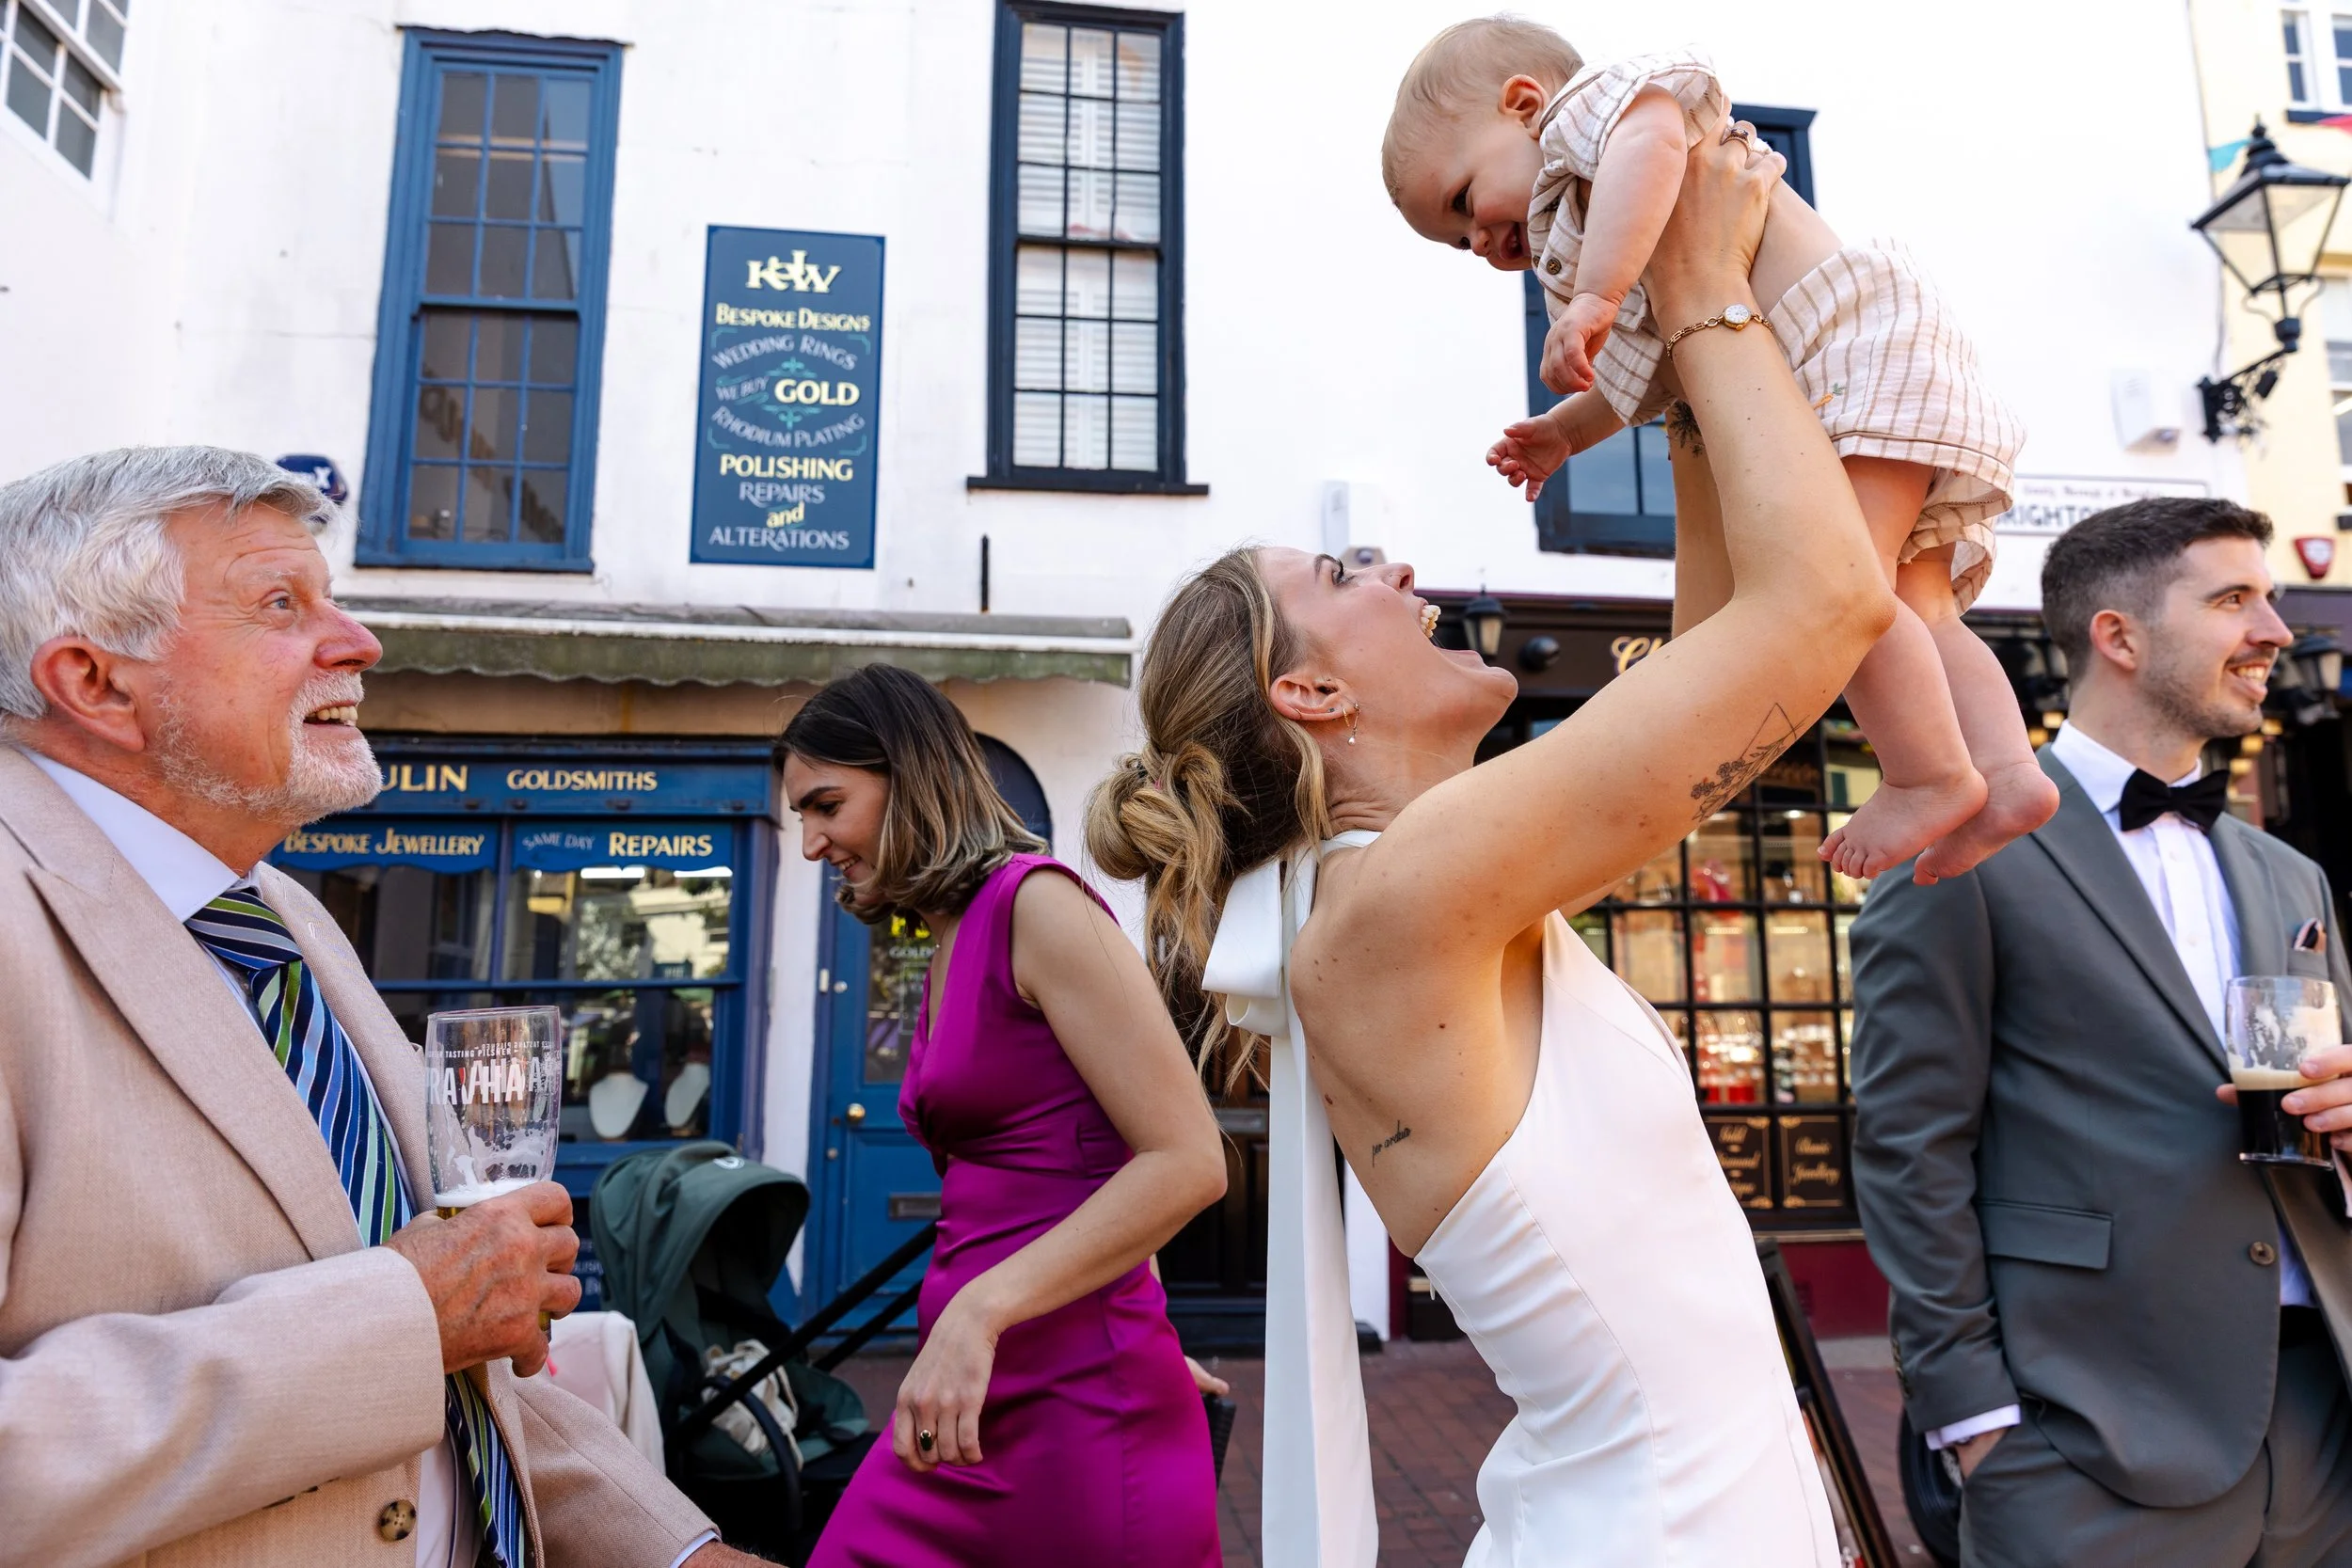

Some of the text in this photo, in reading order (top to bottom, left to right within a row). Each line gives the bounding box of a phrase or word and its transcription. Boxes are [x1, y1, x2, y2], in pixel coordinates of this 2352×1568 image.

[716, 303, 871, 332] BESPOKE DESIGNS
[712, 334, 858, 371] WEDDING RINGS
[739, 376, 769, 397] BUY
[774, 378, 860, 405] GOLD
[711, 405, 866, 448] RHODIUM PLATING
[720, 453, 853, 482] POLISHING
[739, 482, 825, 508] REPAIRS
[767, 501, 804, 528] and
[708, 527, 850, 551] ALTERATIONS
[507, 769, 658, 791] GOLDSMITHS
[284, 828, 485, 855] BESPOKE JEWELLERY
[522, 832, 713, 857] SAME DAY REPAIRS
[445, 1050, 474, 1058] TASTING
[478, 1047, 511, 1057] PILSNER
